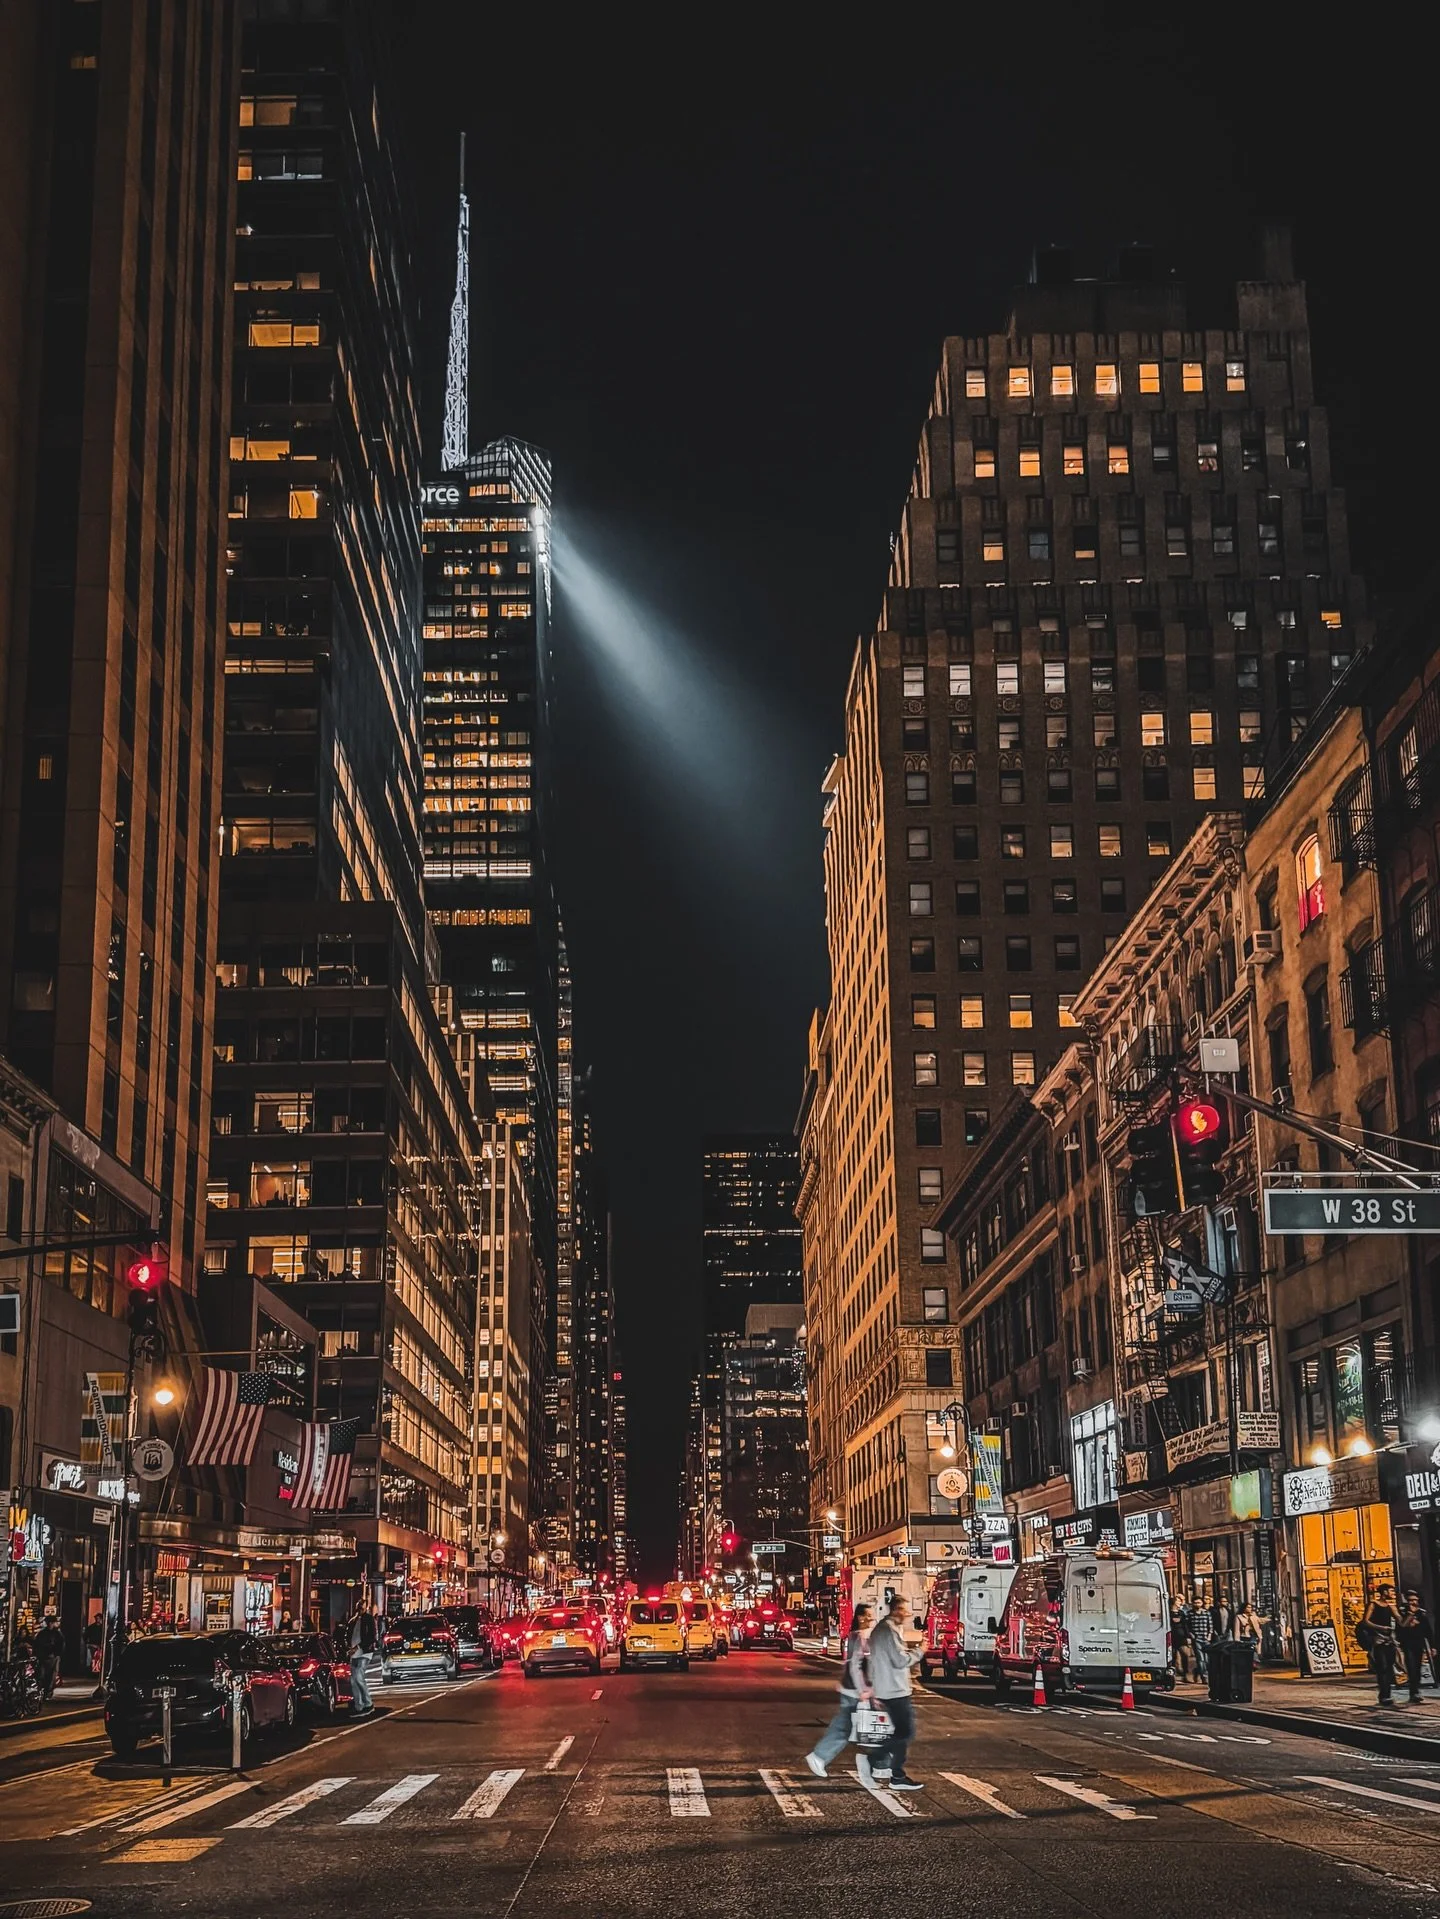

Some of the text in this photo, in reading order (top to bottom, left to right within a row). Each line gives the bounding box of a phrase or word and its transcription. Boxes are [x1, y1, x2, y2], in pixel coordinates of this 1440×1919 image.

[1321, 1199, 1417, 1224] W 38 St
[90, 1379, 113, 1457] #GarmentDistrict
[1304, 1483, 1318, 1500] New
[1078, 1645, 1112, 1654] Spectrum
